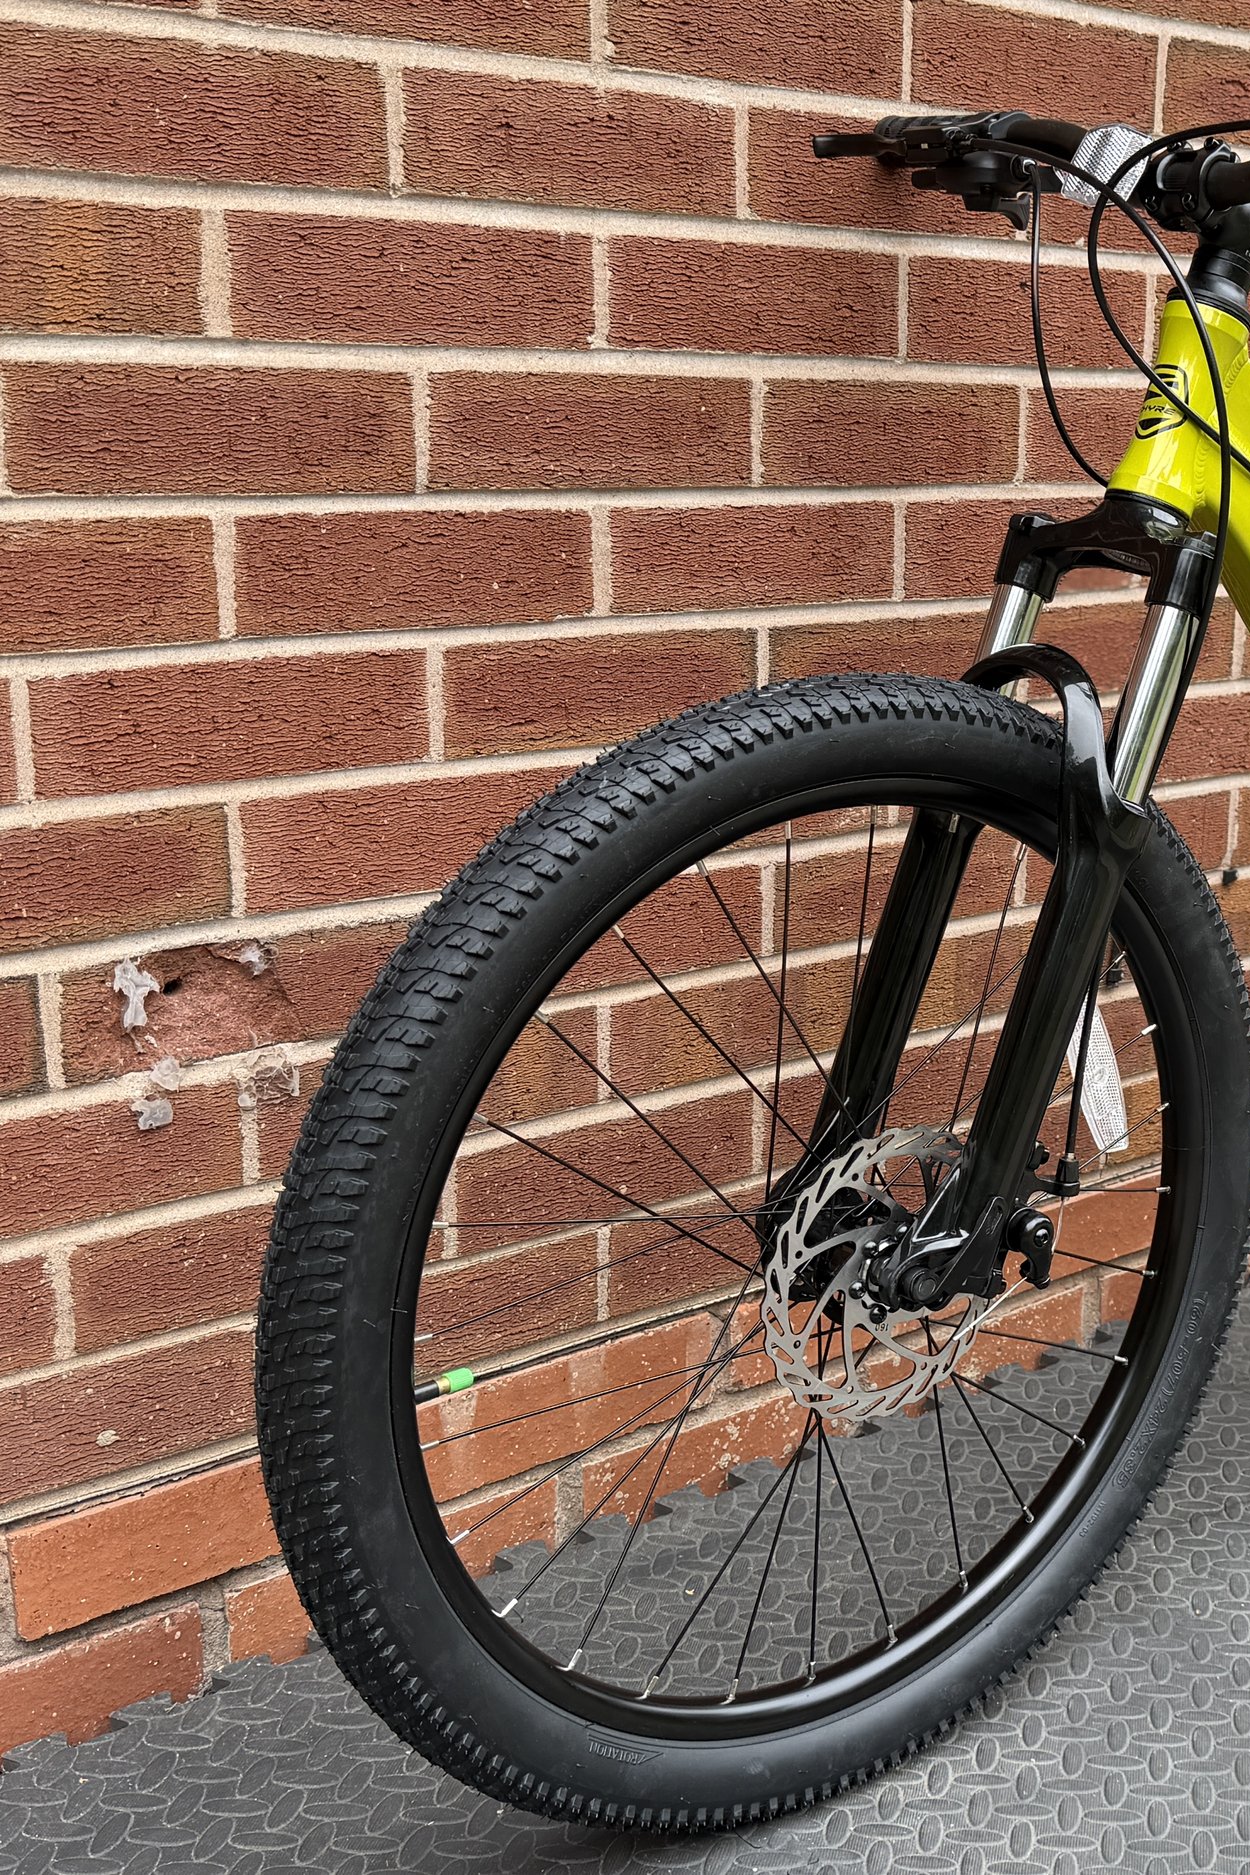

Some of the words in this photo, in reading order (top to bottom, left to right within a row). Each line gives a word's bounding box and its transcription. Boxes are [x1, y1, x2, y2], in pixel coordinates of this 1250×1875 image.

[1141, 405, 1176, 416] HYRE
[874, 1323, 890, 1332] 160
[588, 1740, 638, 1765] ROTATION
